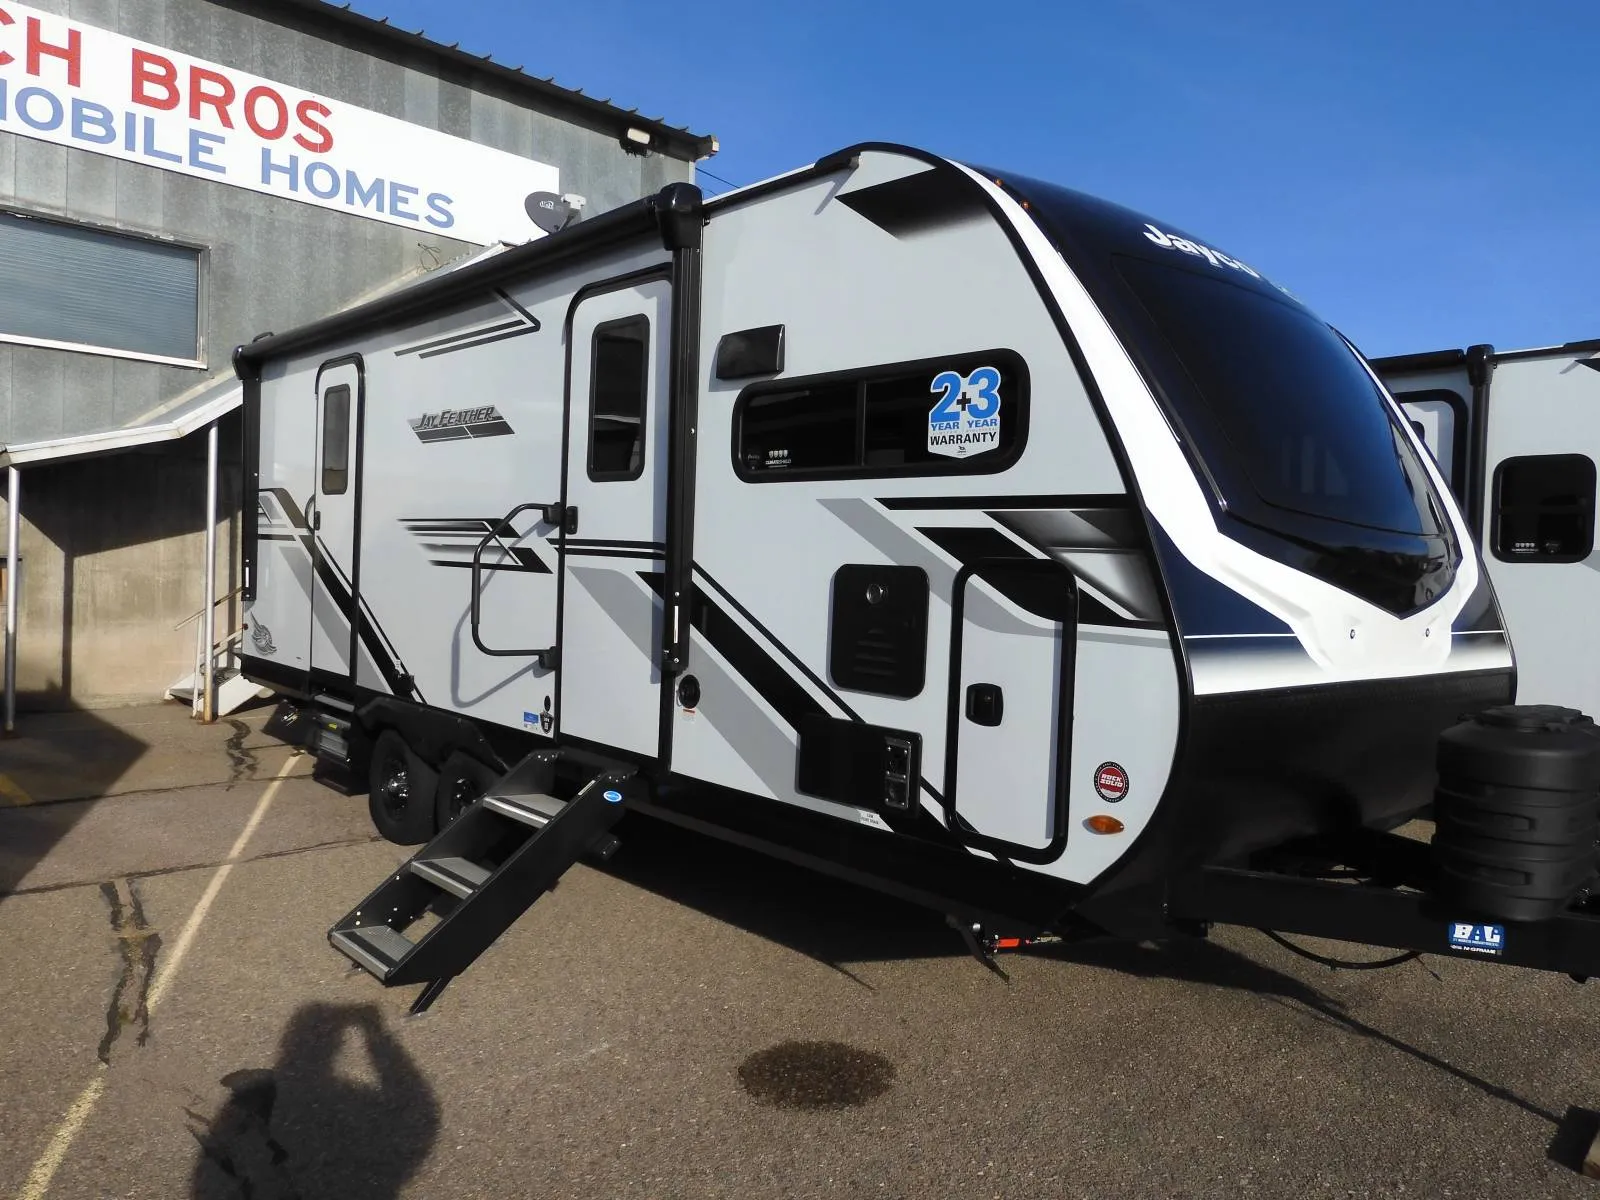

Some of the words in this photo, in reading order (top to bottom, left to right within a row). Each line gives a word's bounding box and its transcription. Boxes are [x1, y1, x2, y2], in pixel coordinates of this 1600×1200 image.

[131, 47, 334, 154] BROS
[0, 77, 226, 175] OBILE
[261, 146, 455, 229] HOMES
[1142, 223, 1261, 279] Jayco
[418, 412, 438, 429] JAY
[439, 405, 495, 427] FEATHER
[930, 421, 960, 431] YEAR
[967, 418, 998, 428] YEAR
[930, 431, 997, 446] WARRANTY
[1100, 779, 1123, 787] SOLID
[1102, 773, 1122, 782] ROCK
[1453, 922, 1501, 943] BAL
